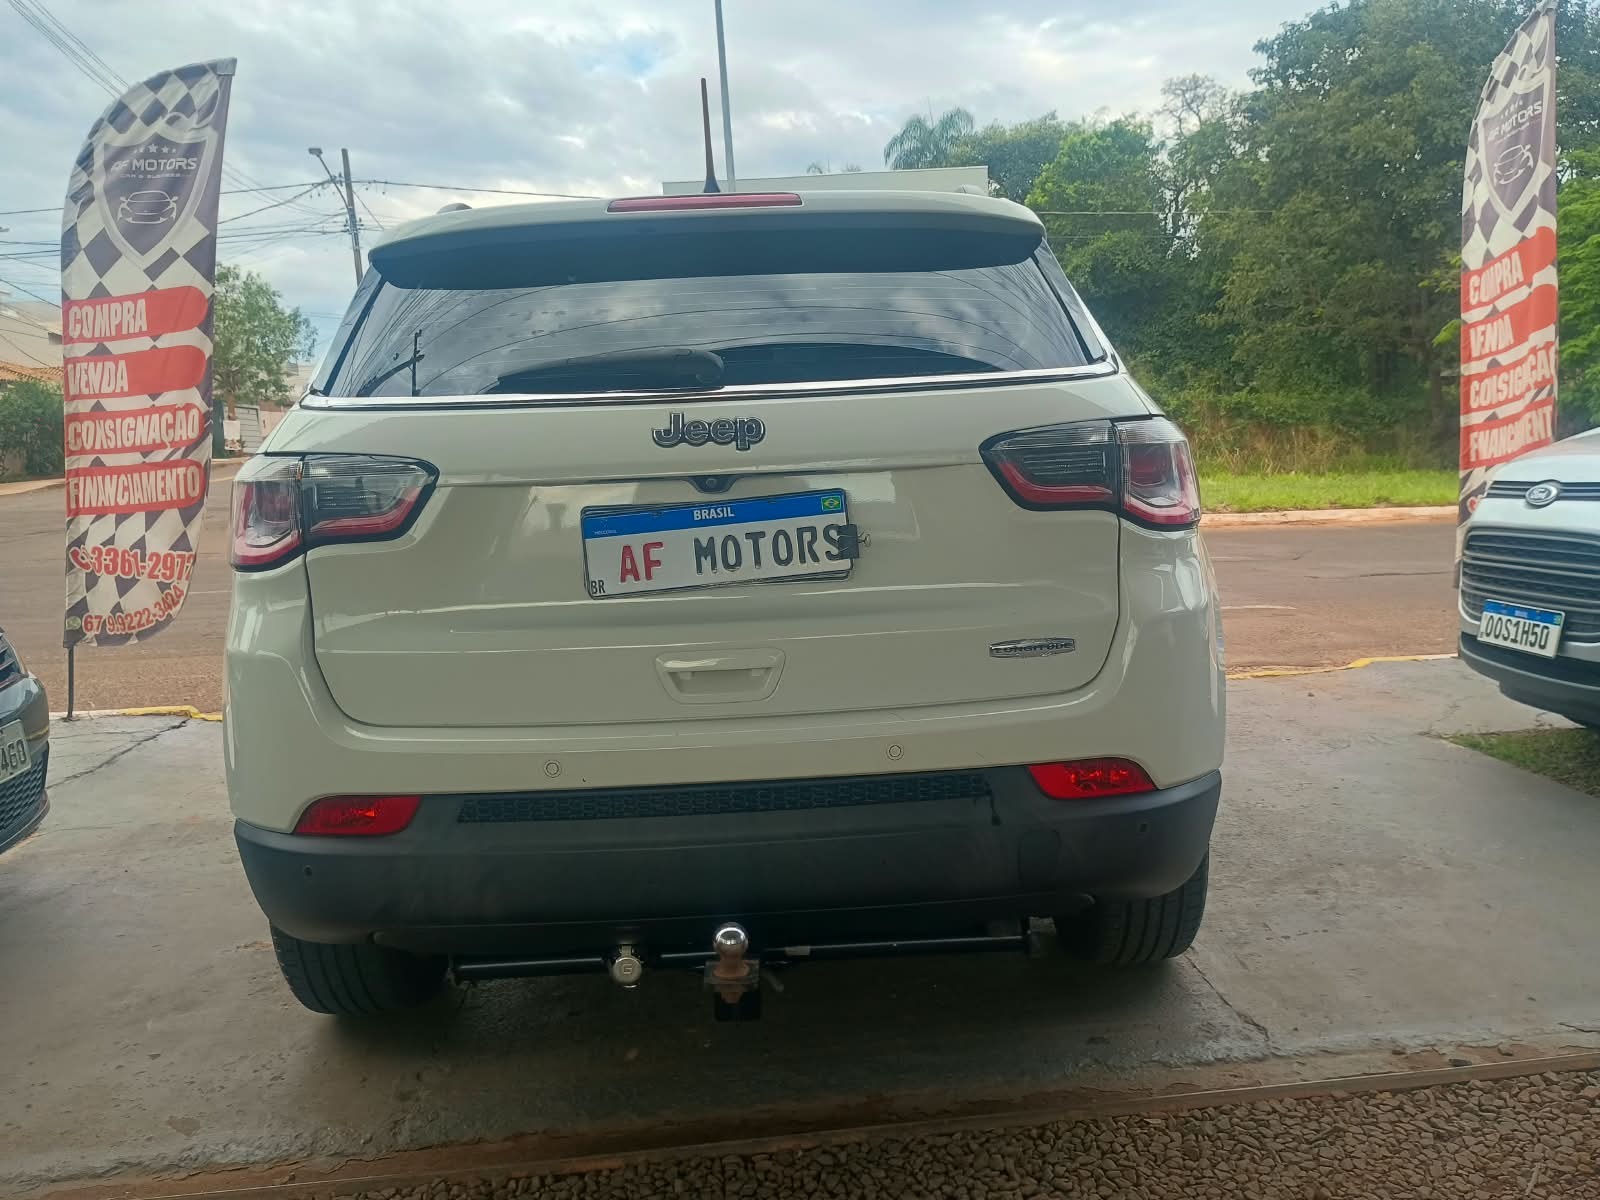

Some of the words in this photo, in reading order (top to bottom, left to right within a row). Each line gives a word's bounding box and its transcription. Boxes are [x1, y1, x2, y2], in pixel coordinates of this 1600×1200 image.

[132, 157, 197, 171] MOTORS
[68, 299, 148, 339] COMPRA
[67, 360, 129, 395] VENDA
[652, 412, 766, 451] Jeep
[69, 464, 200, 509] FINANCIAMENTO
[693, 506, 735, 521] BRASIL
[619, 541, 664, 584] AF
[693, 523, 846, 576] MOTORS
[590, 579, 606, 595] BR
[84, 615, 102, 632] 67
[0, 739, 27, 771] 460
